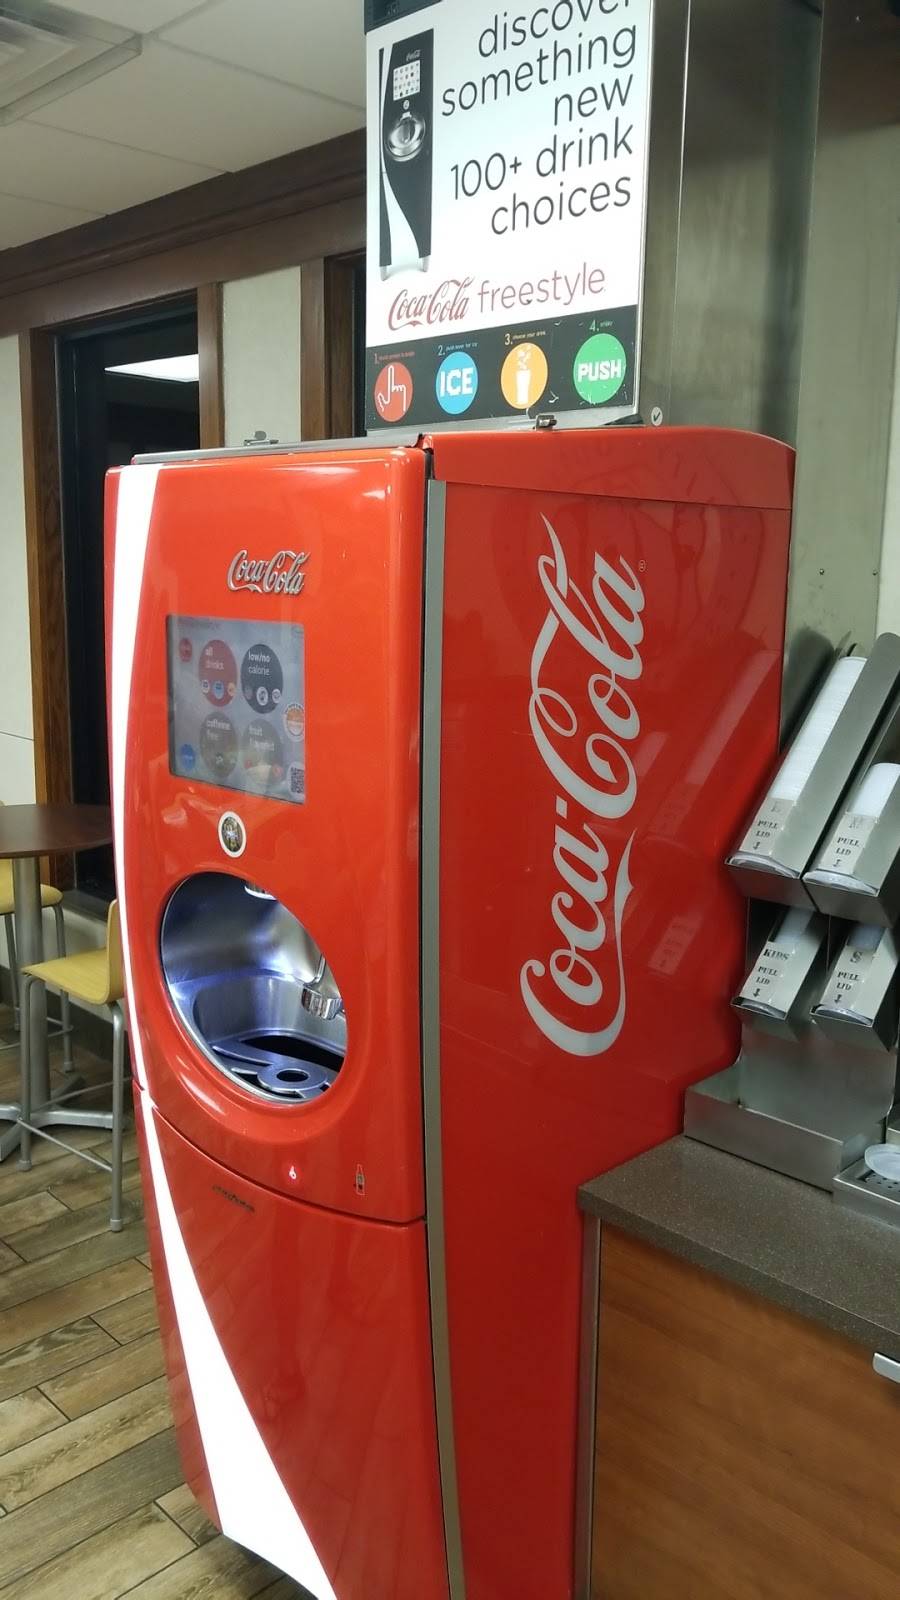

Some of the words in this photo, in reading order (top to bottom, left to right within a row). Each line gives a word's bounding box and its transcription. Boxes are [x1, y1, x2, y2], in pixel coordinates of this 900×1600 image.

[478, 0, 629, 58] discov
[441, 25, 637, 117] something
[553, 74, 634, 126] new
[450, 152, 522, 200] 100+
[536, 116, 634, 178] drink
[491, 176, 632, 235] choices
[387, 276, 475, 332] Coca-Cola
[477, 262, 606, 313] freestyle
[589, 319, 600, 332] 4.
[504, 333, 513, 346] 3.
[438, 345, 446, 356] 2.
[577, 359, 623, 383] PUSH
[439, 366, 474, 397] ICE
[227, 549, 311, 596] Coca-Cola
[205, 646, 214, 657] all
[248, 650, 271, 663] low/no
[248, 664, 271, 676] calorie
[520, 511, 647, 1057] Coca-Cola
[757, 820, 778, 830] PULL
[755, 830, 771, 838] LID
[837, 836, 860, 847] PULL
[835, 847, 851, 856] LID
[763, 948, 790, 961] KIDS
[850, 951, 863, 963] S
[757, 966, 778, 977] PULL
[837, 971, 860, 982] PULL
[755, 977, 770, 985] LID
[836, 982, 852, 991] LID
